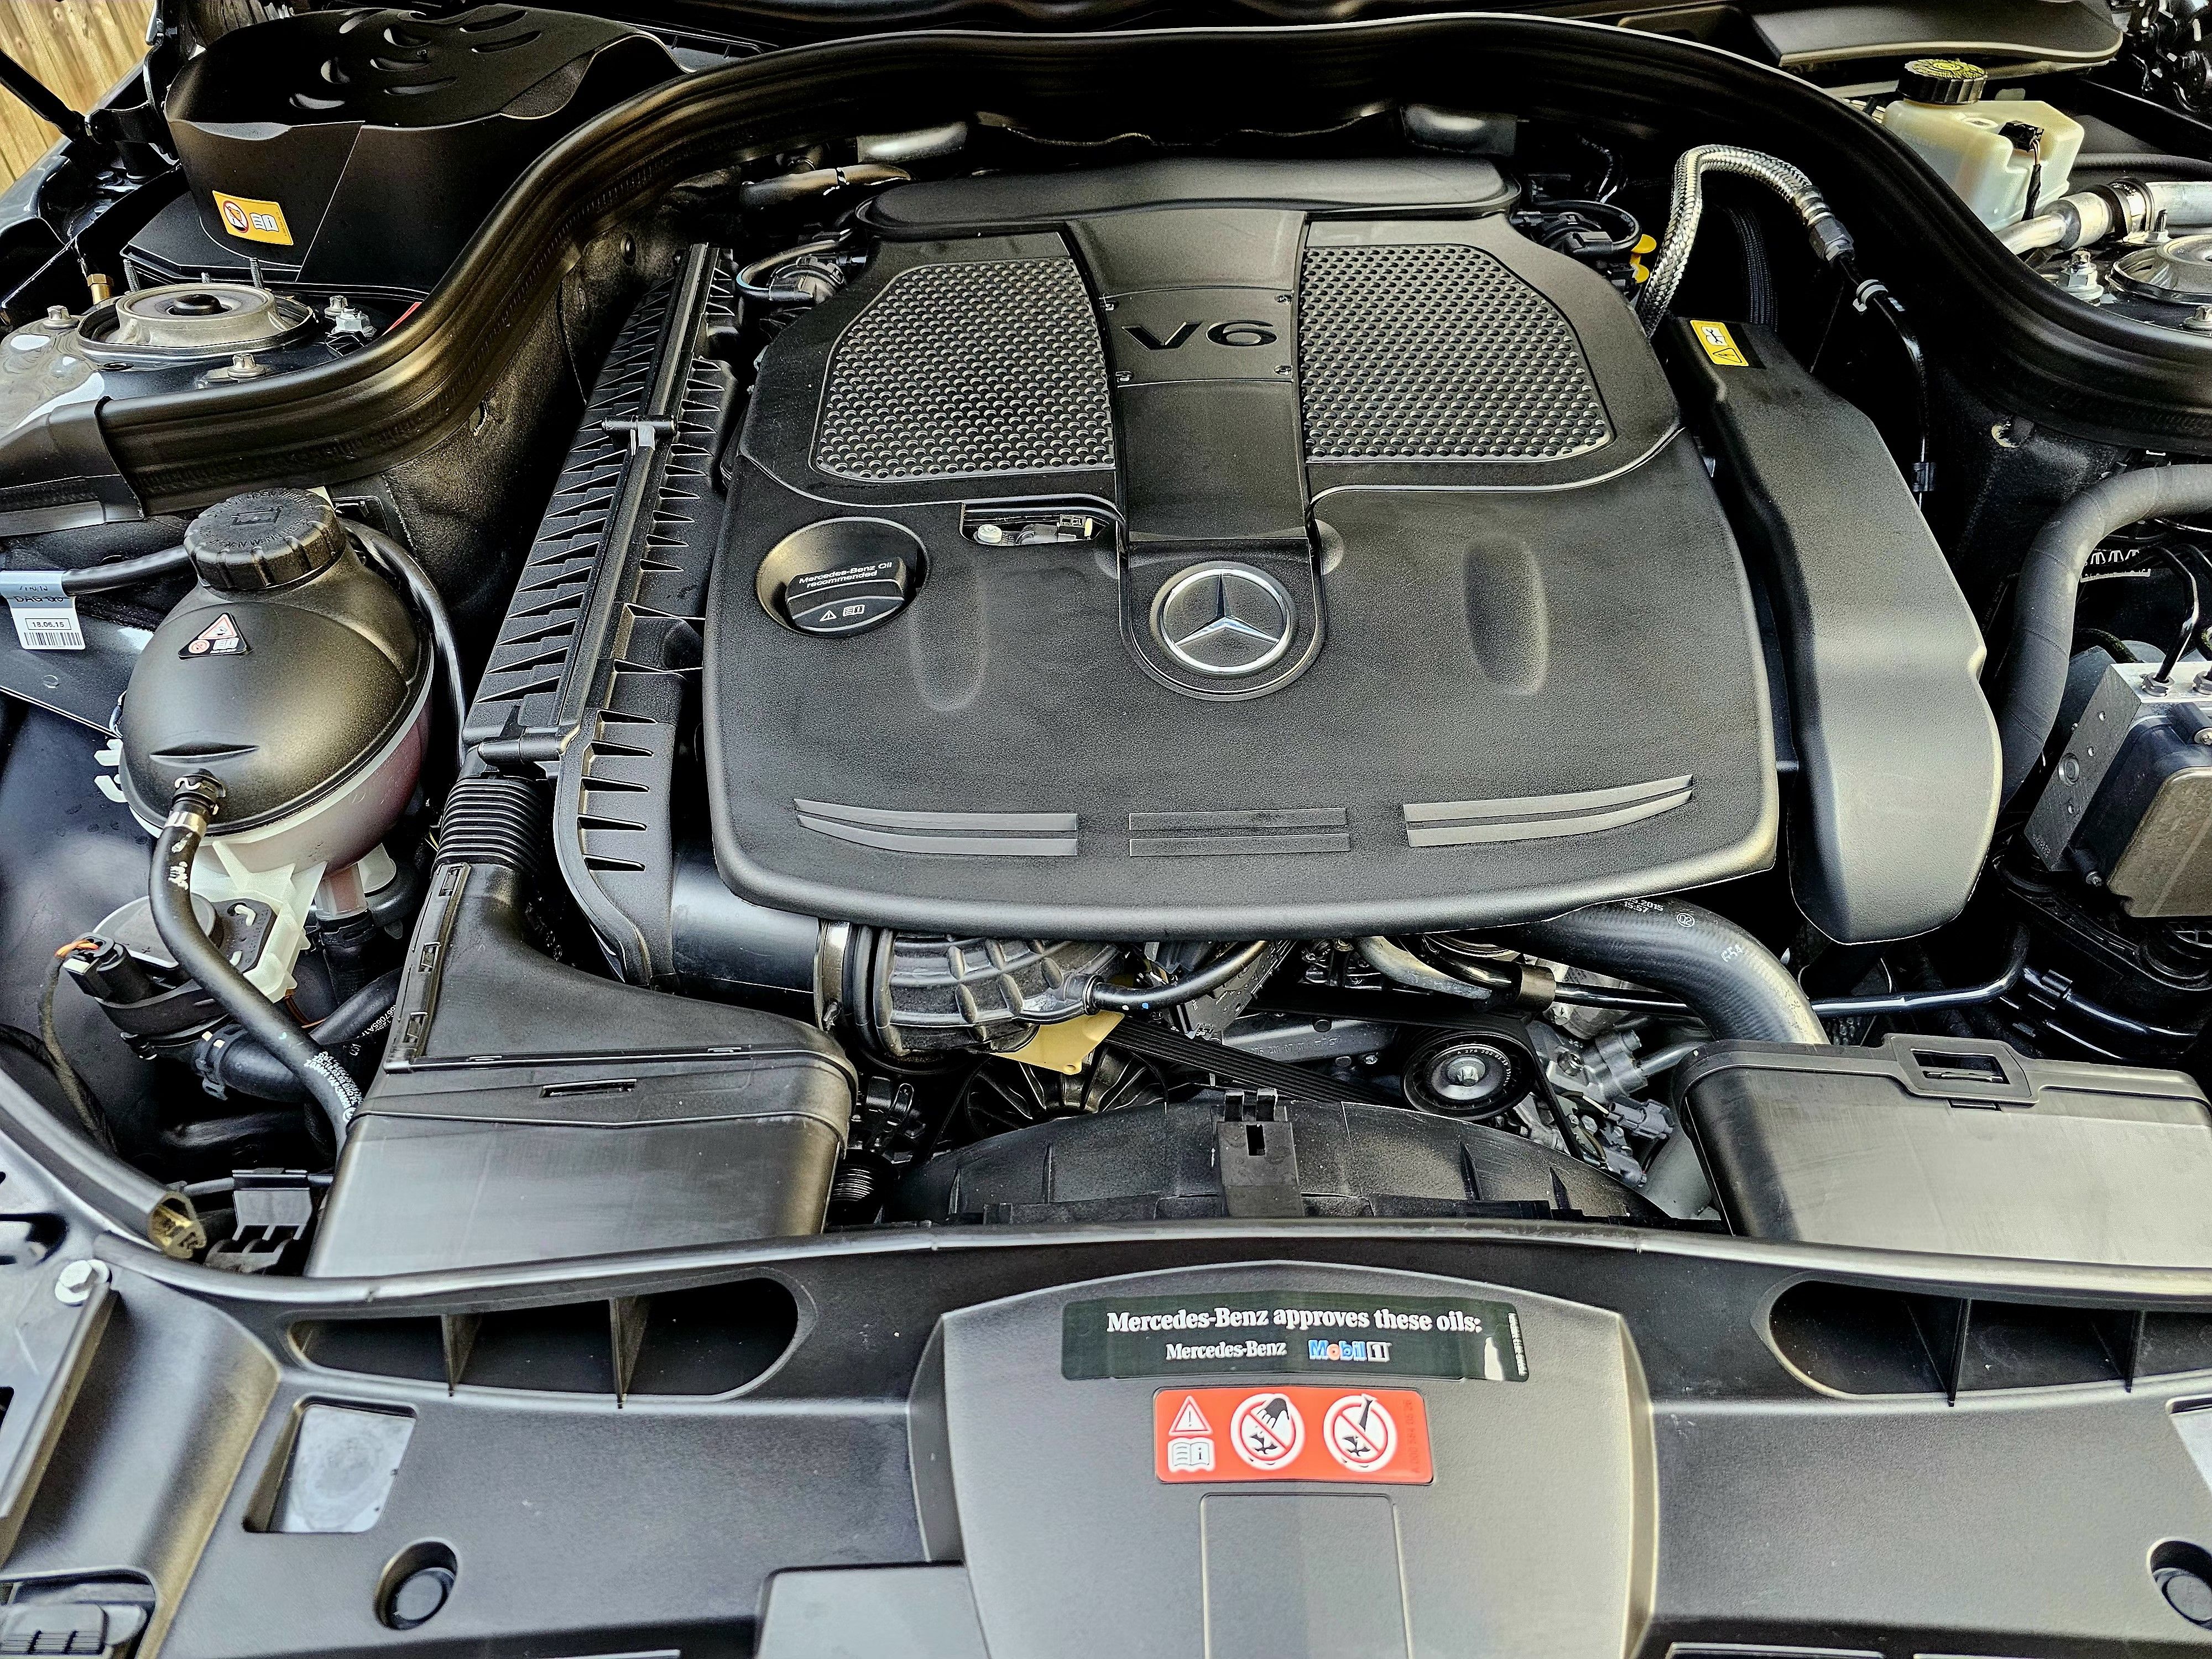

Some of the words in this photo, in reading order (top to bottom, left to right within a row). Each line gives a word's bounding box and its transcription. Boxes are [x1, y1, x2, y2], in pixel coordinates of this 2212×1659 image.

[1121, 319, 1277, 350] V6
[799, 565, 876, 584] Mercedes-Benz
[806, 570, 877, 588] recommended
[1107, 1307, 1269, 1332] Mercedes-Benz
[1273, 1308, 1370, 1330] approves
[1374, 1308, 1433, 1331] these
[1436, 1311, 1483, 1333] oils:
[1166, 1340, 1287, 1360] Mercedes-Benz
[1308, 1339, 1367, 1361] Mobil
